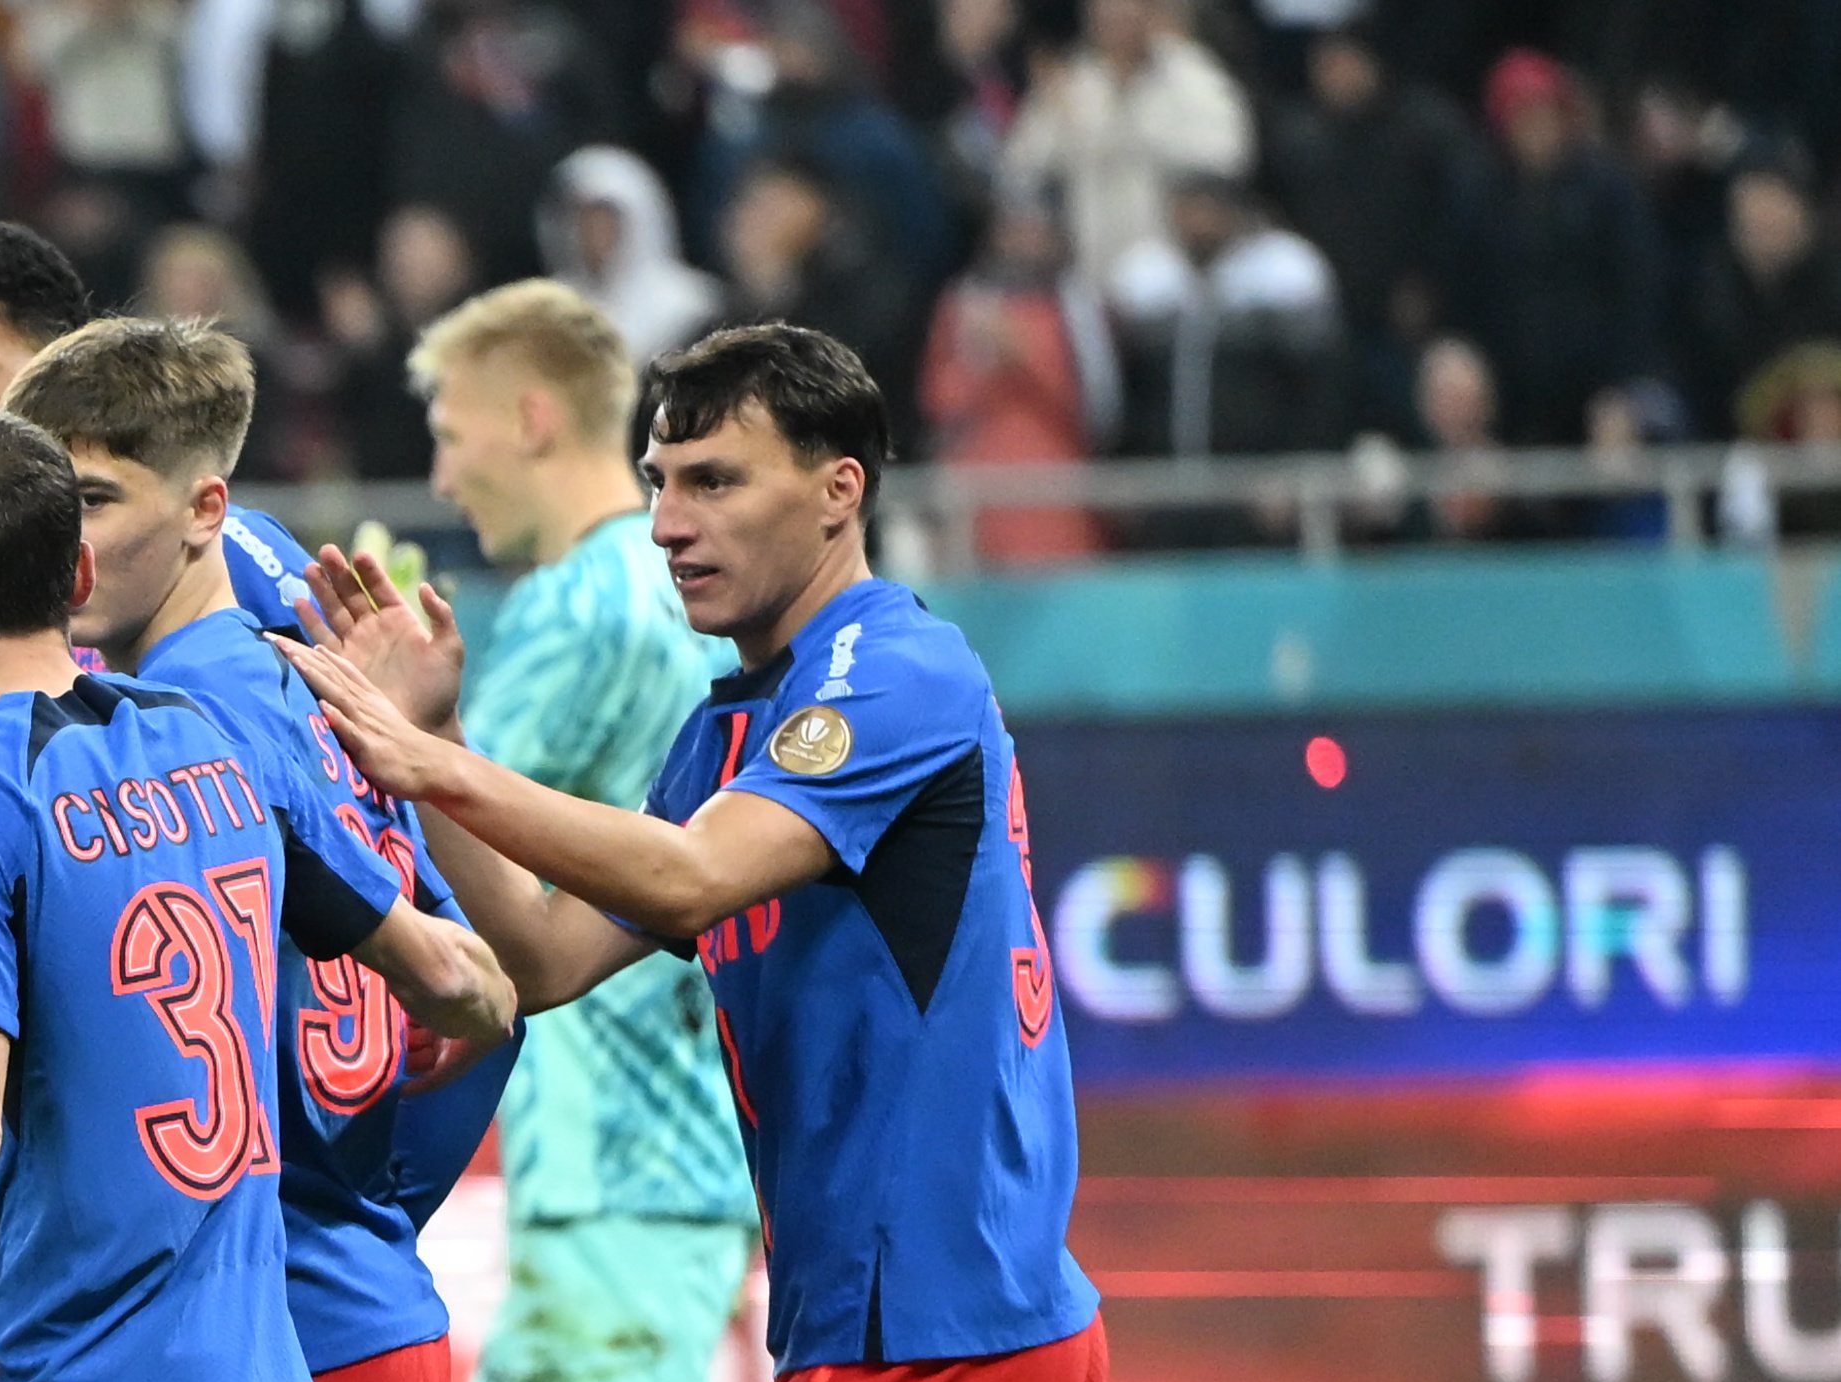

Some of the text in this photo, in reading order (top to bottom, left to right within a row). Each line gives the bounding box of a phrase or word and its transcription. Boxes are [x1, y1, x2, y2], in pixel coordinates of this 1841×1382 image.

[52, 757, 266, 862] CISOTTI
[1053, 841, 1750, 1023] CULORI
[111, 857, 280, 1201] 31
